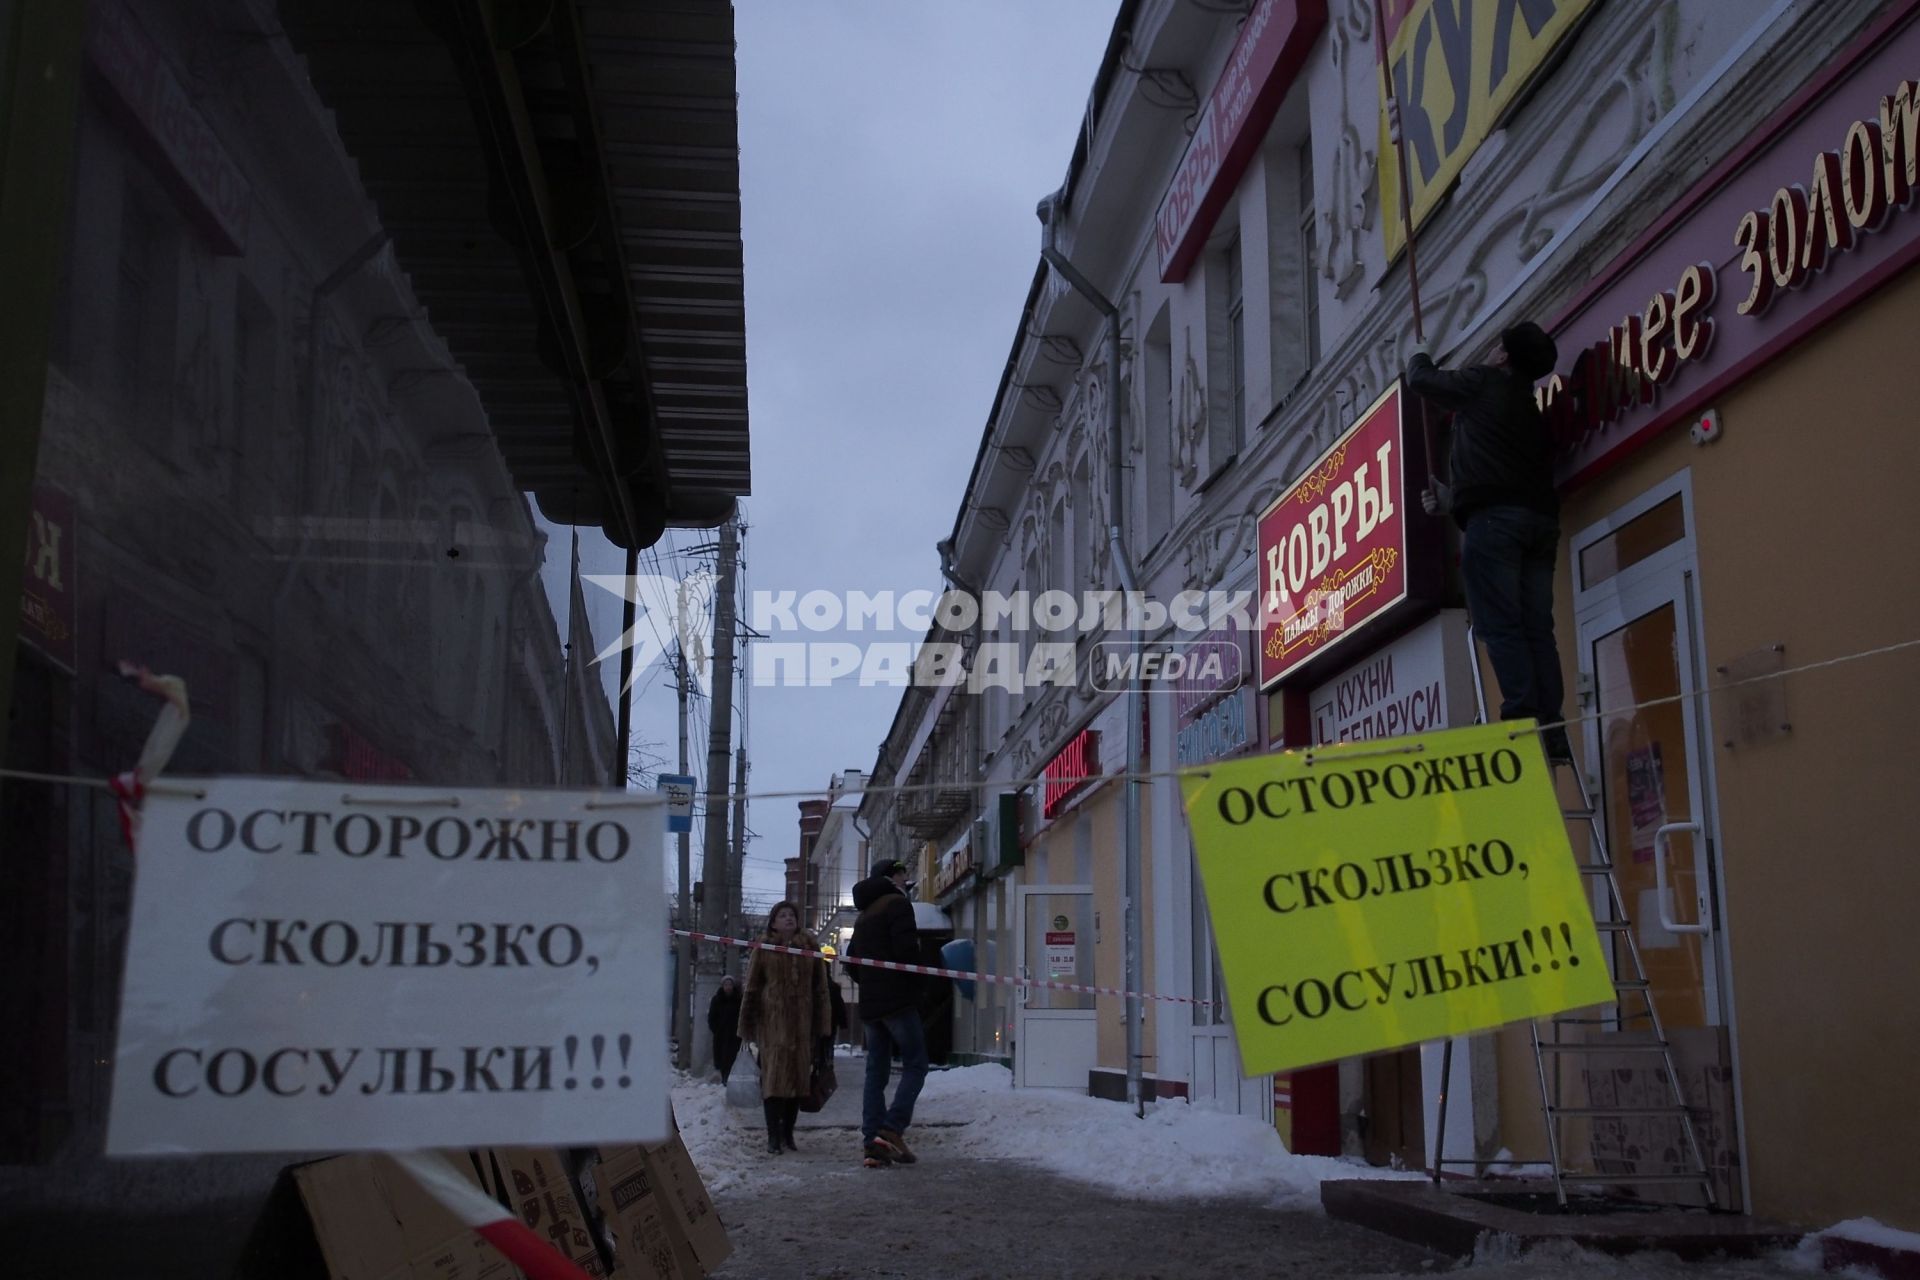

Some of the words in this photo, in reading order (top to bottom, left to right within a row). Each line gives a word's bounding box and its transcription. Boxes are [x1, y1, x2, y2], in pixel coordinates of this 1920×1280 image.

[1158, 108, 1219, 260] КОВРЫ
[1267, 440, 1394, 611] КОВРЫ
[1337, 655, 1394, 722] КУХНИ
[1044, 728, 1089, 811] ДИОНИС
[1217, 748, 1523, 825] ОСТОРОЖНО
[186, 808, 630, 863] ОСТОРОЖНО
[1262, 839, 1530, 914] СКОЛЬЗКО,
[208, 918, 600, 975] СКОЛЬЗКО,
[1256, 922, 1581, 1027] СОСУЛЬКИ!!!
[153, 1033, 632, 1097] СОСУЛЬКИ!!!
